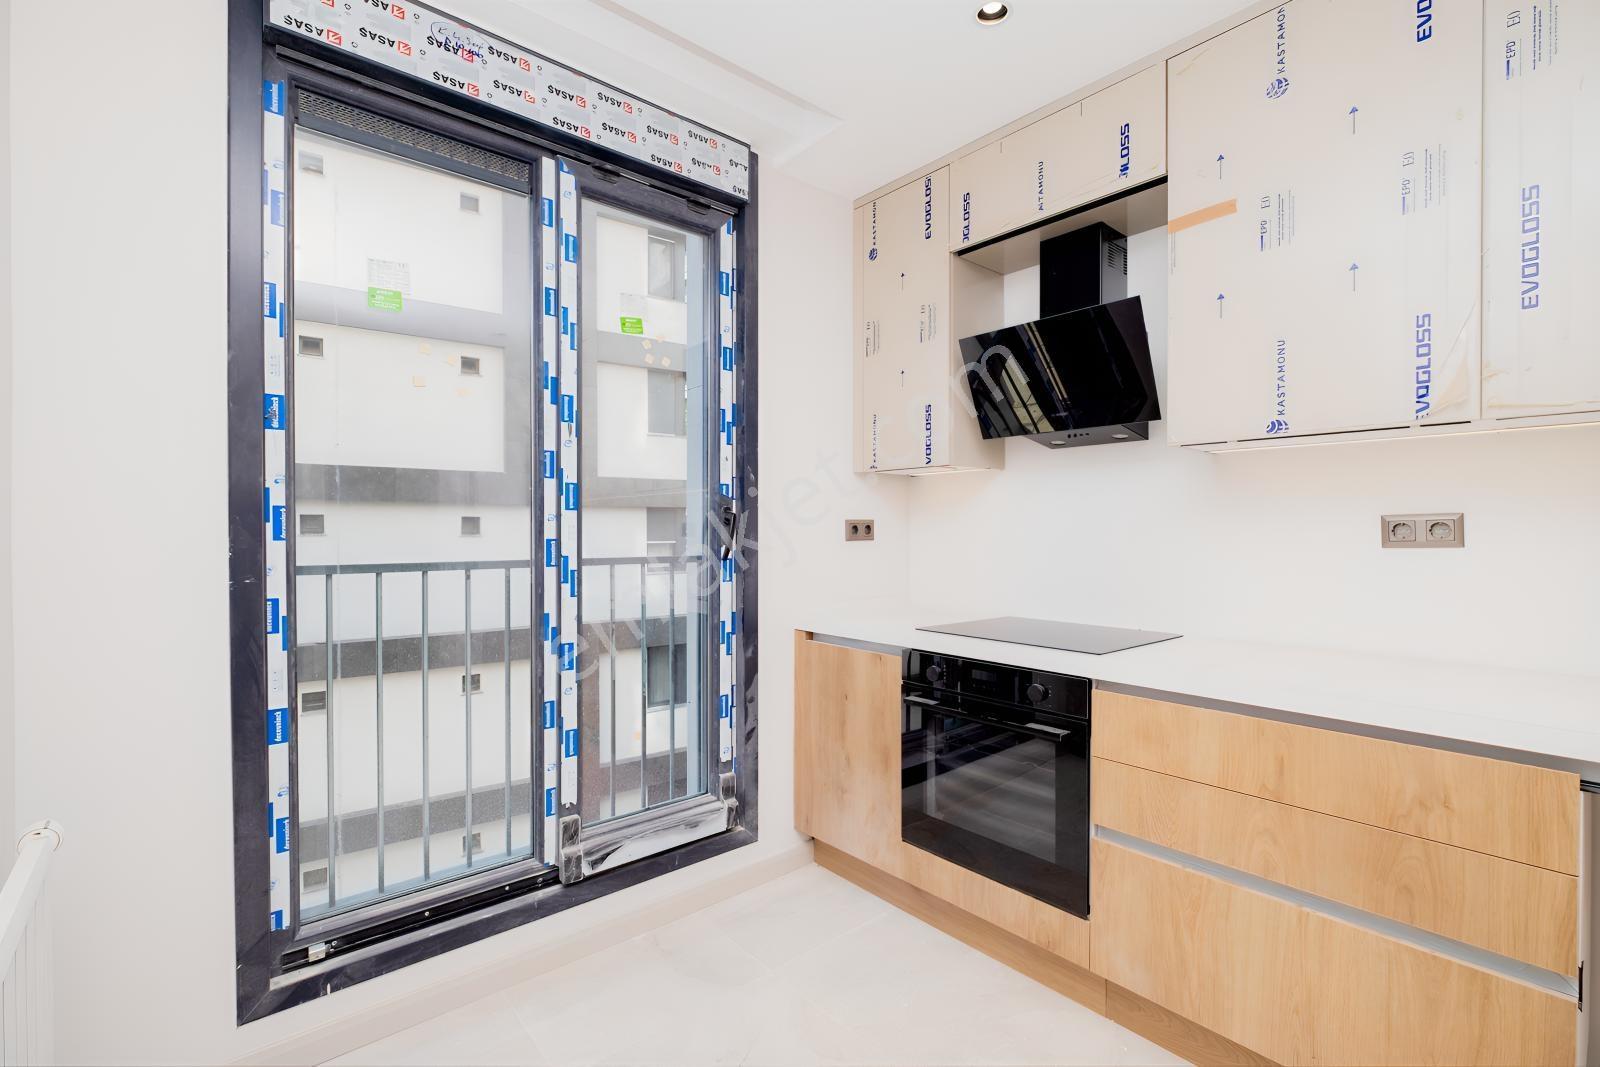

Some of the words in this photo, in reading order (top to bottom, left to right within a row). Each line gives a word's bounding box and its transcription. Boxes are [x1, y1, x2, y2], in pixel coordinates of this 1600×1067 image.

[283, 15, 324, 37] ASAS
[359, 27, 395, 48] ASAS
[487, 45, 518, 64] ASAS
[432, 71, 465, 90] ASAS
[493, 80, 522, 97] ASAS
[547, 84, 575, 102] ASAS
[597, 92, 622, 108] ASAS
[552, 116, 579, 133] ASAS
[601, 122, 626, 137] ASAS
[1521, 184, 1540, 310] EVOGLOSS
[1277, 339, 1286, 416] KASTAMONU
